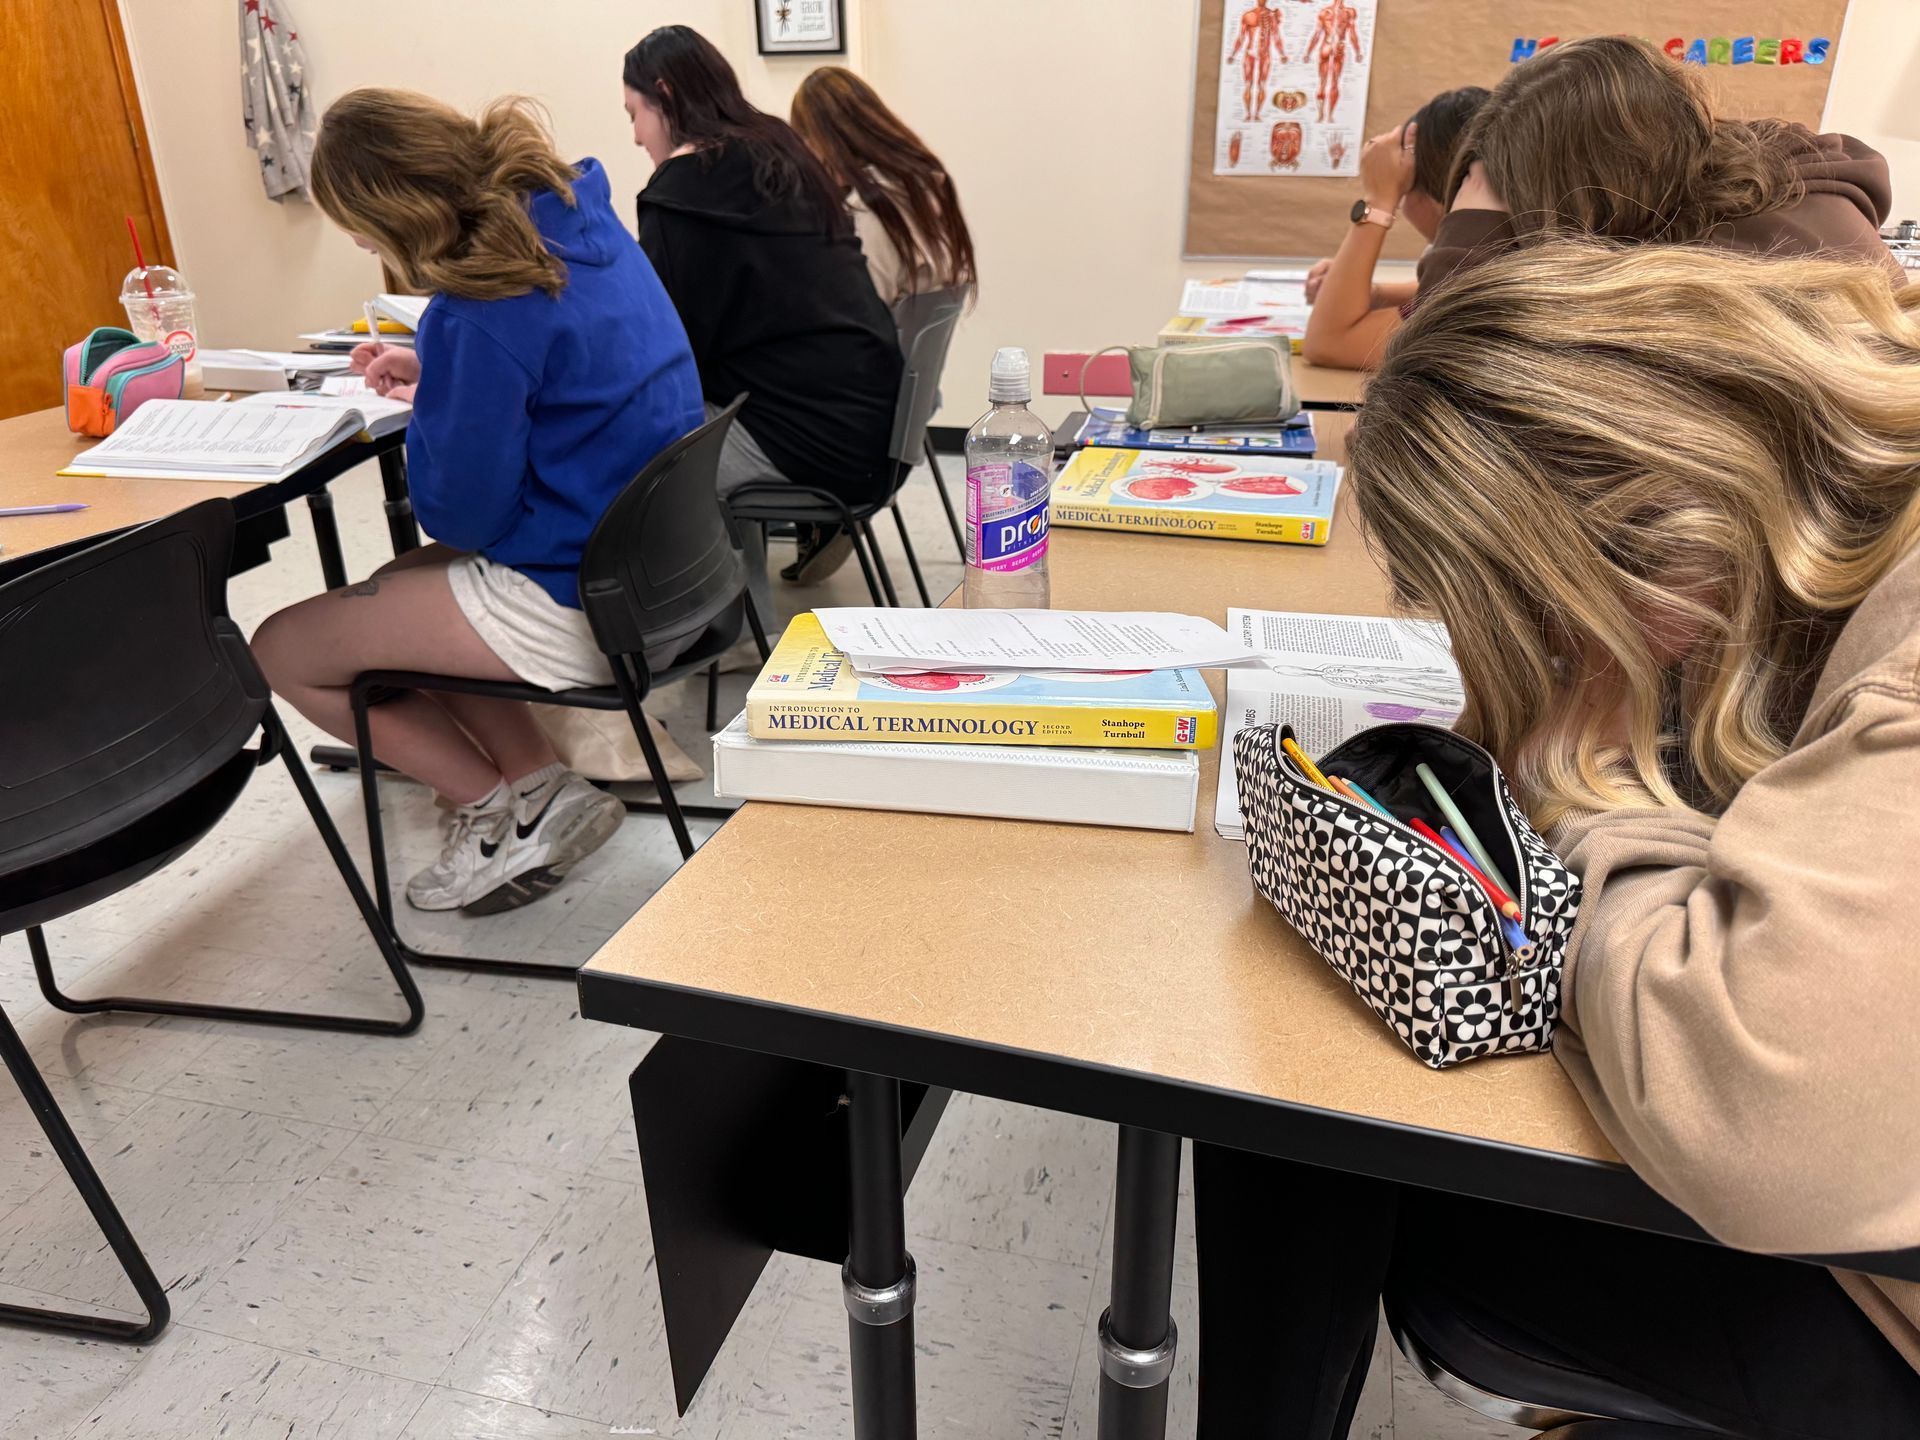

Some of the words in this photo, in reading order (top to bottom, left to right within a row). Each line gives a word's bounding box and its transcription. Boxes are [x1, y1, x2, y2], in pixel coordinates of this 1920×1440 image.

[1663, 36, 1831, 66] CAREERS
[1056, 510, 1115, 523] MEDICAL
[1116, 514, 1216, 531] TERMINOLOGY
[1255, 521, 1283, 529] Stanhope
[1256, 528, 1283, 536] Turnbull
[807, 659, 843, 691] Medical
[769, 705, 844, 713] INTRODUCTION
[768, 714, 869, 731] MEDICAL
[873, 716, 1039, 736] TERMINOLOGY
[1101, 719, 1146, 729] Stanhope
[1177, 718, 1189, 742] G-W
[1103, 730, 1146, 739] Turnbull
